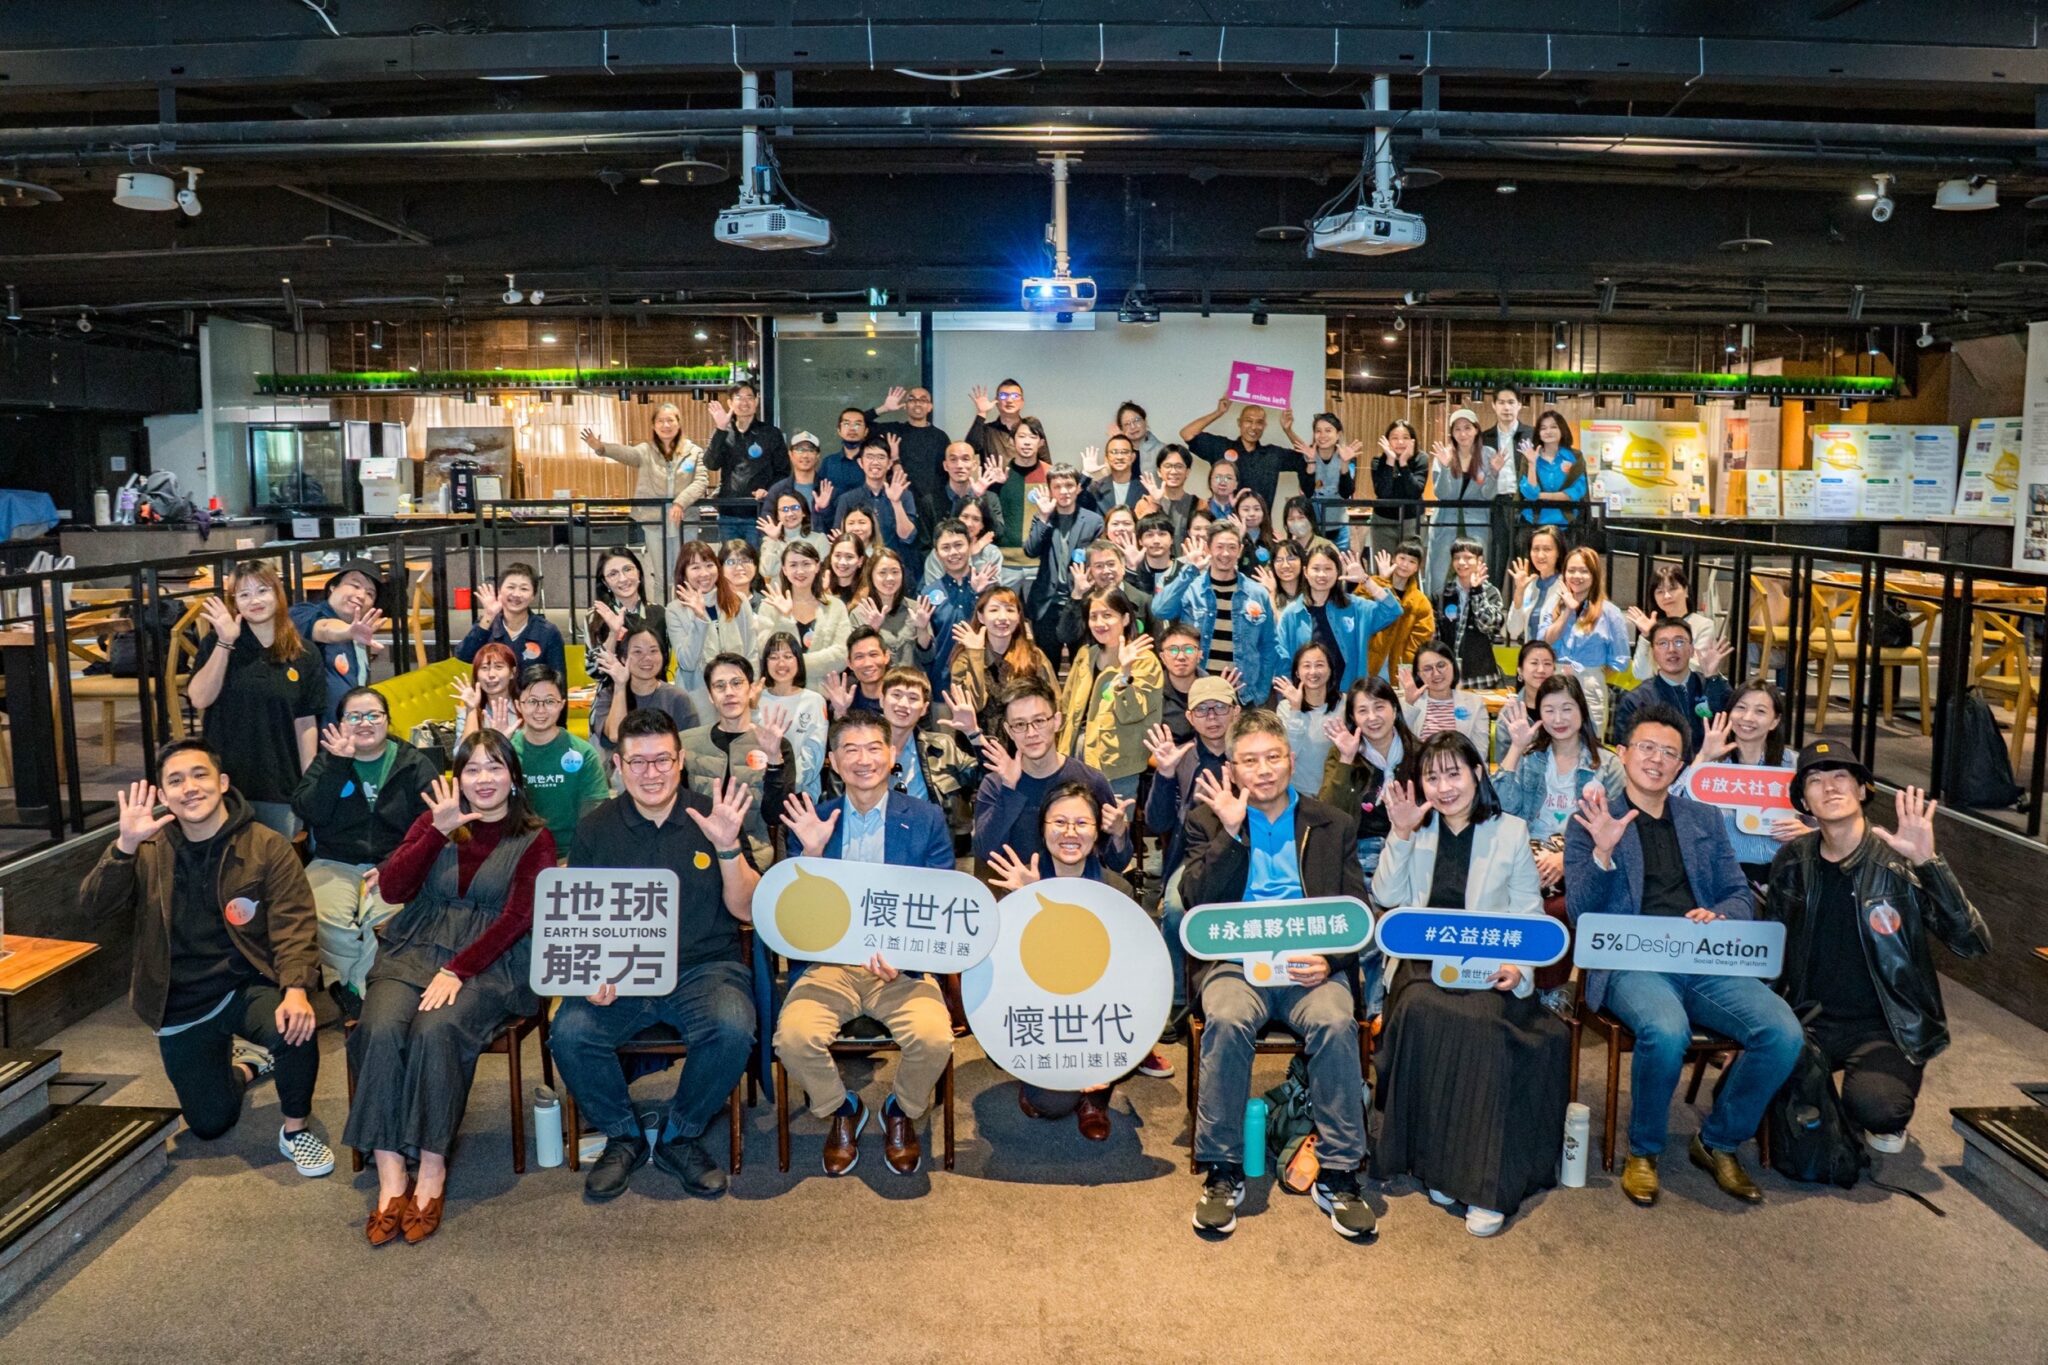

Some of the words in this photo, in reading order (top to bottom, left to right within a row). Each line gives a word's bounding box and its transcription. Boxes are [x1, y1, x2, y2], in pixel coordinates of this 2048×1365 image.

[1232, 373, 1251, 399] 1
[1252, 394, 1271, 402] mins
[1272, 396, 1286, 405] left
[545, 880, 668, 921] 地球
[860, 888, 980, 937] 懷世代
[544, 927, 588, 938] EARTH
[592, 927, 667, 938] SOLUTIONS
[1208, 914, 1349, 941] #永續夥伴關係
[1425, 925, 1523, 948] #公益接棒
[541, 943, 665, 985] 解方
[1694, 957, 1714, 965] Social
[1715, 959, 1738, 967] Design
[1003, 1003, 1135, 1047] 懷世代
